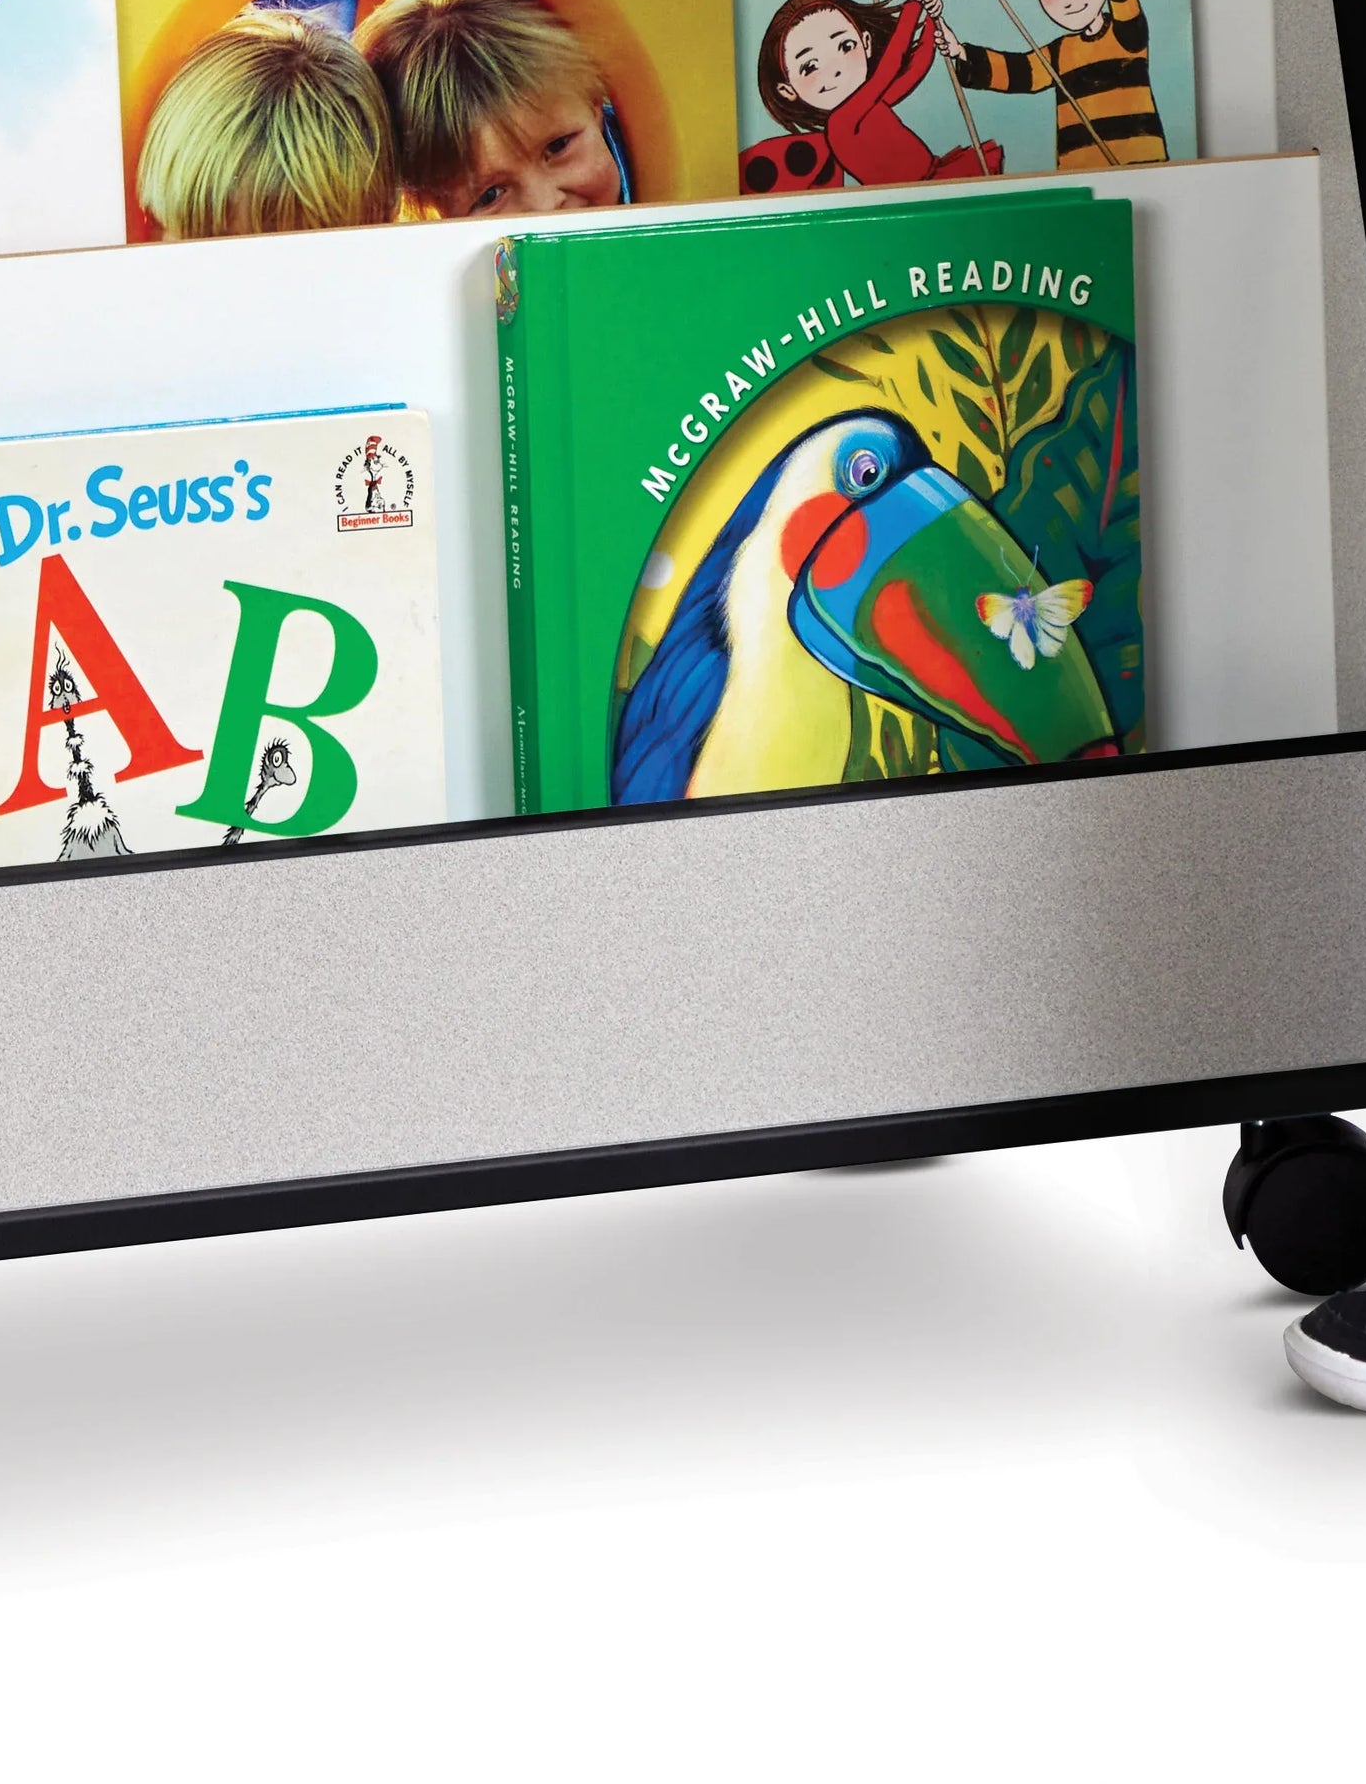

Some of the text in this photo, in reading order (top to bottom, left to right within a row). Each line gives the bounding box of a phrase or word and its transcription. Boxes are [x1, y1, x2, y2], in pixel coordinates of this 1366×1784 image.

[640, 260, 1094, 503] McGRAW-HILL READING
[336, 455, 353, 480] READ
[354, 446, 362, 456] IT
[505, 356, 521, 589] McGRAW-HILL READING
[85, 458, 273, 538] Seuss's
[335, 484, 345, 504] CAN
[383, 444, 415, 508] ALL BY MYSELF
[341, 513, 409, 528] Beginner Books
